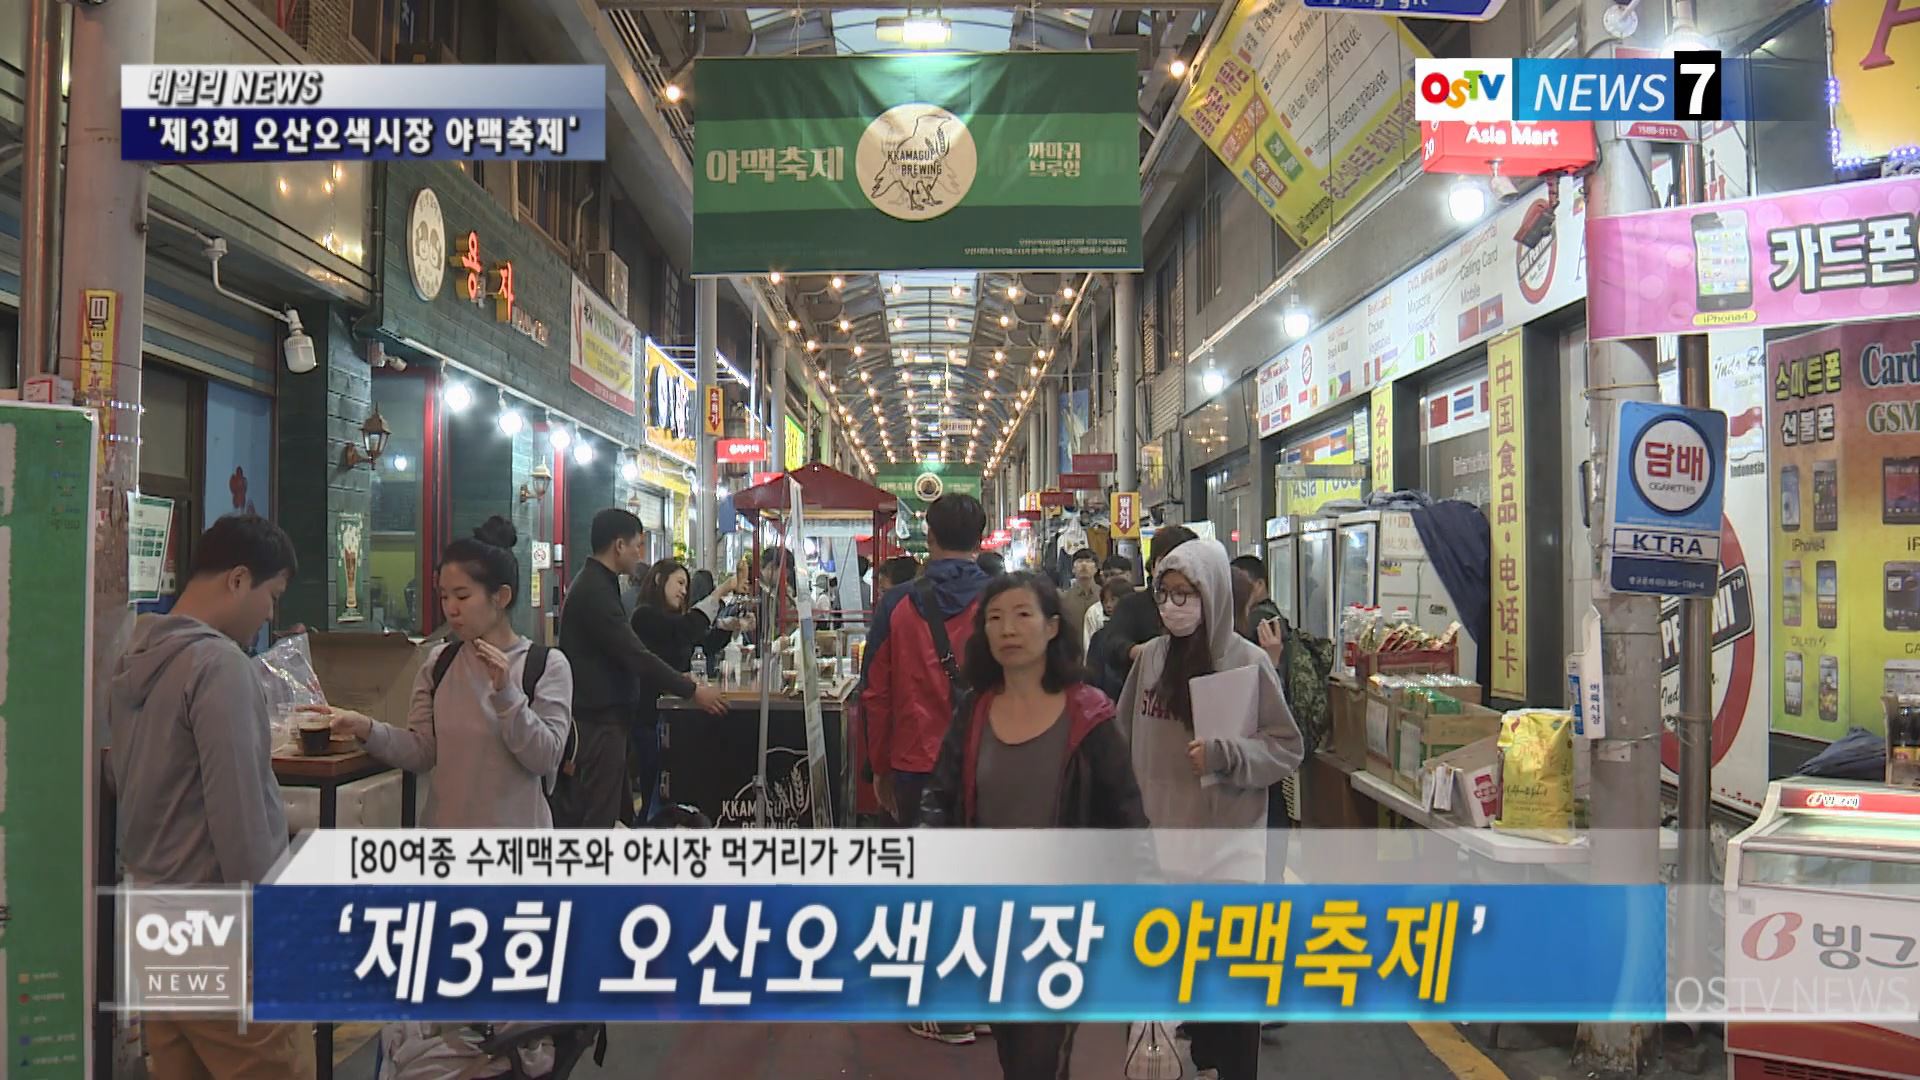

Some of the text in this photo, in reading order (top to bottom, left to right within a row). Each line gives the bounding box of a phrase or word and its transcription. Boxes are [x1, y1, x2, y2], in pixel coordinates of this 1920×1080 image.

[1028, 142, 1080, 159] 까마귀
[1465, 125, 1560, 146] Asia Mart
[706, 146, 844, 184] 야맥축제
[901, 163, 943, 176] BREWING
[1767, 212, 1917, 294] 카드폰
[1775, 348, 1842, 401] 스마트폰
[1781, 403, 1836, 447] 선불폰
[1644, 441, 1705, 483] 담배
[1633, 533, 1704, 556] KTRA
